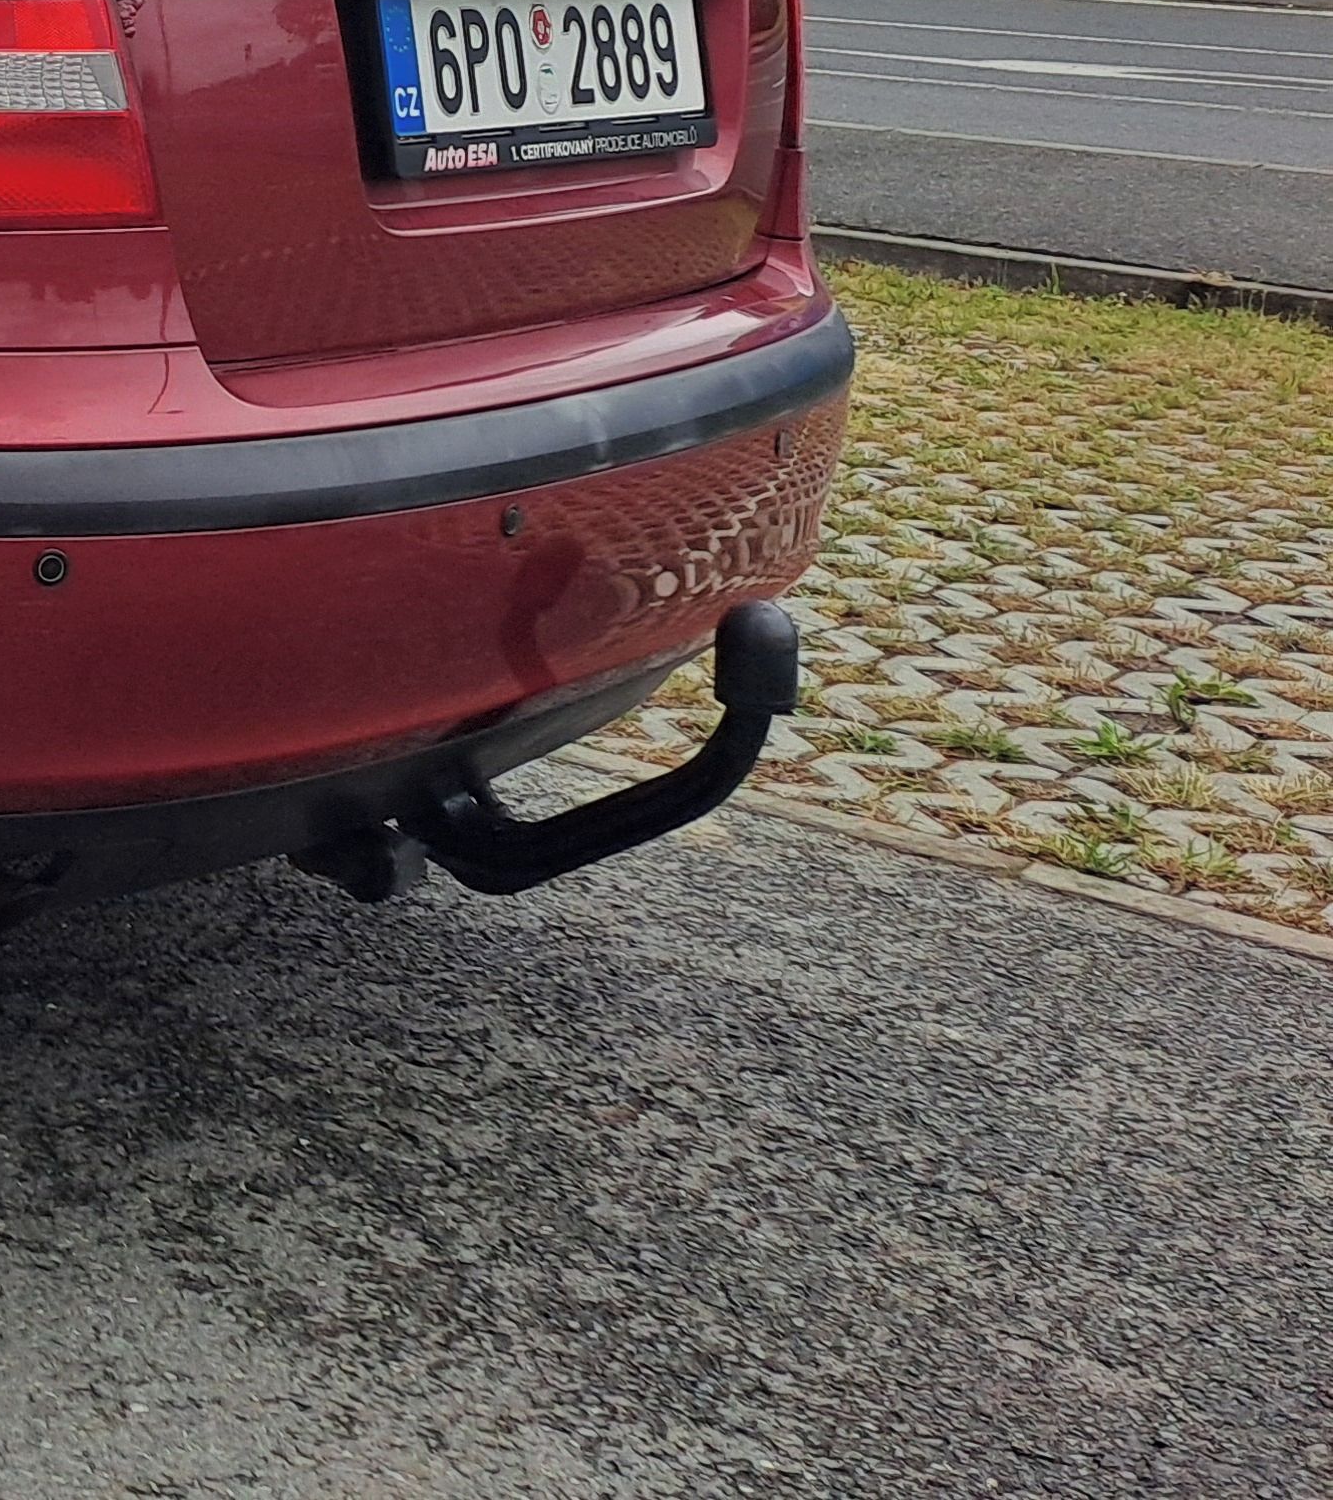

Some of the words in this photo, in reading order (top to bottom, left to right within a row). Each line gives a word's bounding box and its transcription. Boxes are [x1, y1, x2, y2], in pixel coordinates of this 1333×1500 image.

[430, 6, 528, 116] 6P0
[562, 3, 679, 105] 2889
[394, 86, 422, 119] CZ
[424, 143, 465, 172] Auto
[466, 142, 498, 168] ESA
[520, 135, 594, 161] CERTIFIKOVANÝ
[595, 134, 641, 154] PRODEJCE
[642, 126, 698, 149] AUTOMOBILŮ
